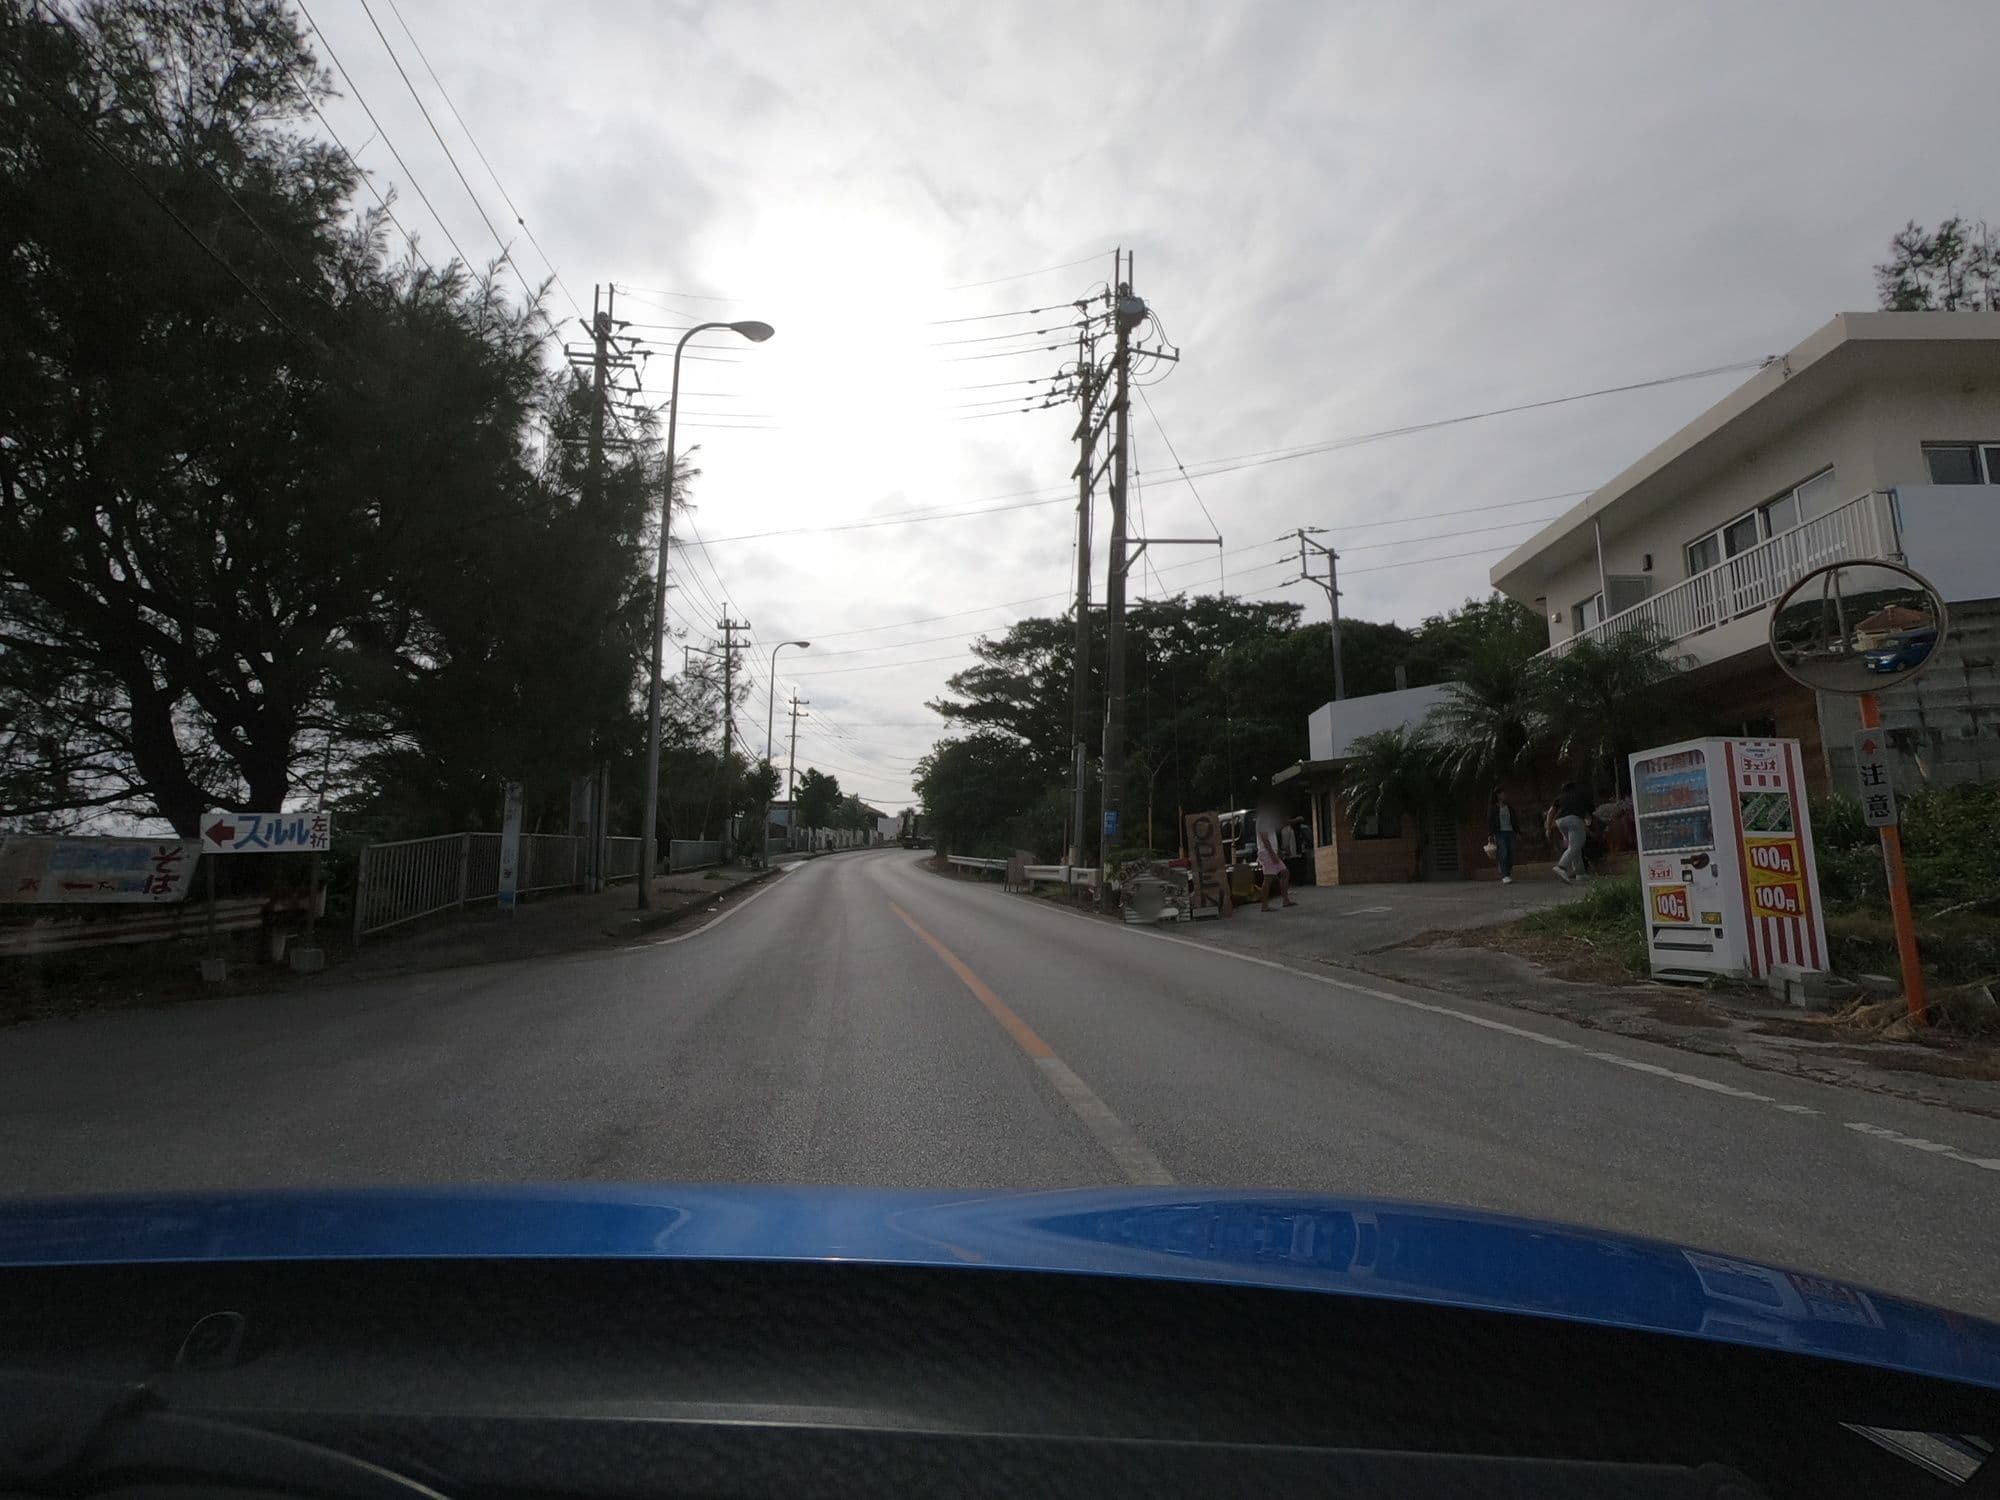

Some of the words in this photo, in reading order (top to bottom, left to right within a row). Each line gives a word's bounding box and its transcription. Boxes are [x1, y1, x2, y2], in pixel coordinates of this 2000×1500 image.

[1860, 763, 1891, 818] 注意
[233, 816, 310, 849] スルル
[310, 816, 328, 848] 左折
[142, 845, 183, 895] そば
[1194, 816, 1224, 915] OPEN
[1751, 846, 1791, 872] 100円
[1755, 886, 1796, 912] 100円
